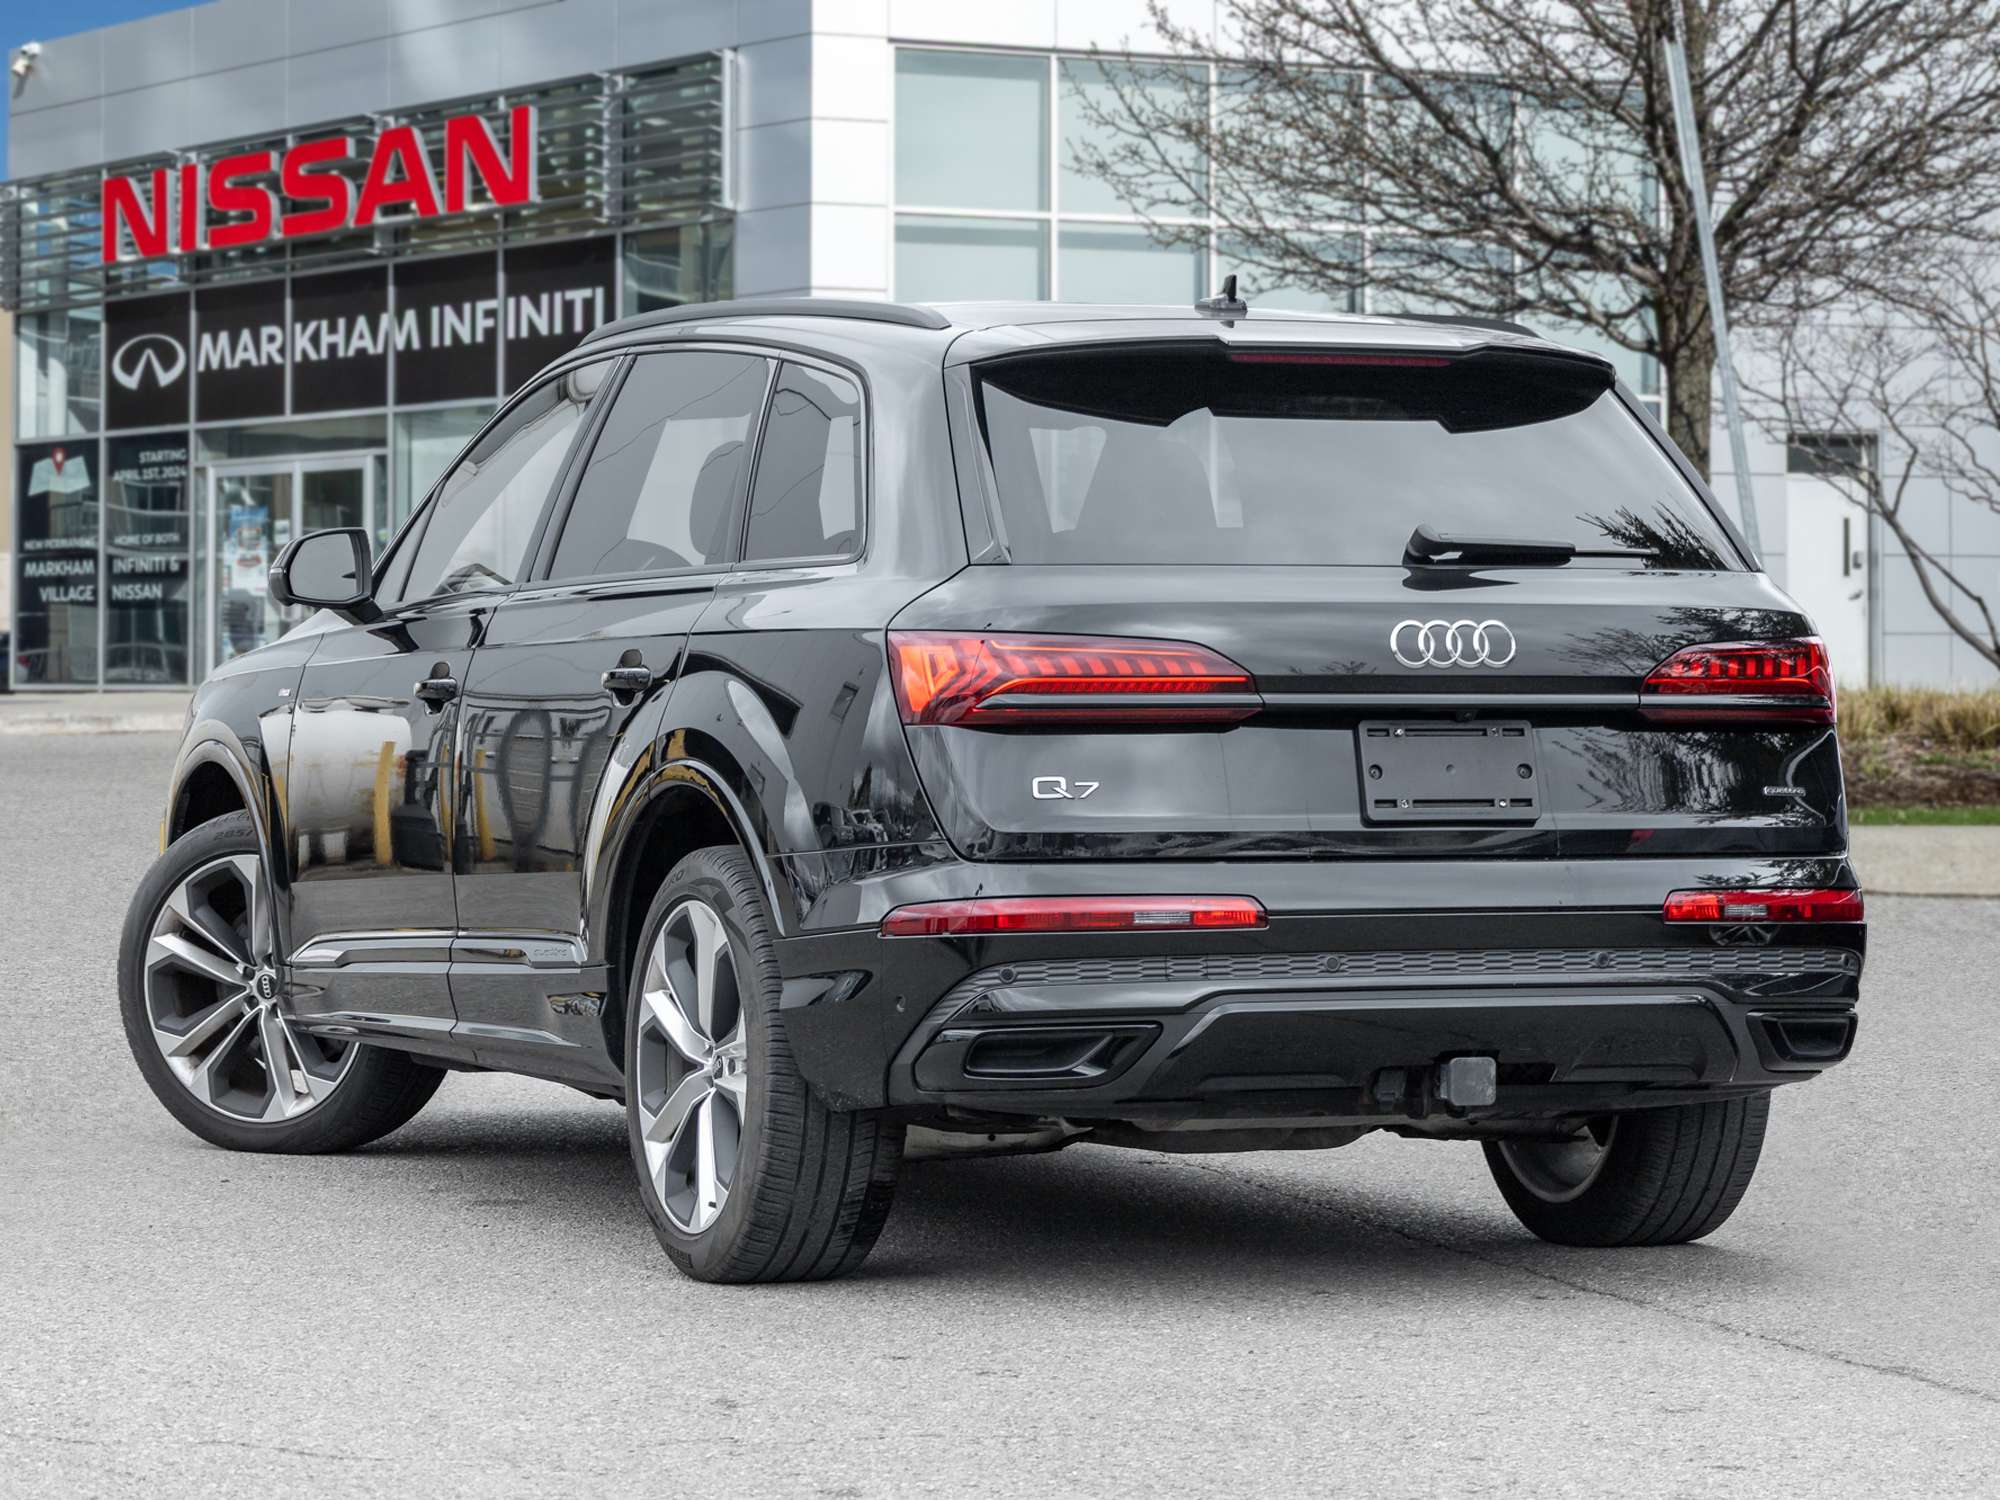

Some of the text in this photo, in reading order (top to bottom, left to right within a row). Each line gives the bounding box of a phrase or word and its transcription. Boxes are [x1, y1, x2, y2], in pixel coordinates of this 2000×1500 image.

[102, 104, 534, 264] NISSAN
[198, 286, 605, 372] MARKHAM INFINITI
[139, 448, 187, 464] STARTING
[24, 559, 95, 577] MARKHAM
[112, 556, 168, 574] INFINITI
[39, 583, 163, 602] VILLAGE NISSAN
[1032, 776, 1099, 799] Q7
